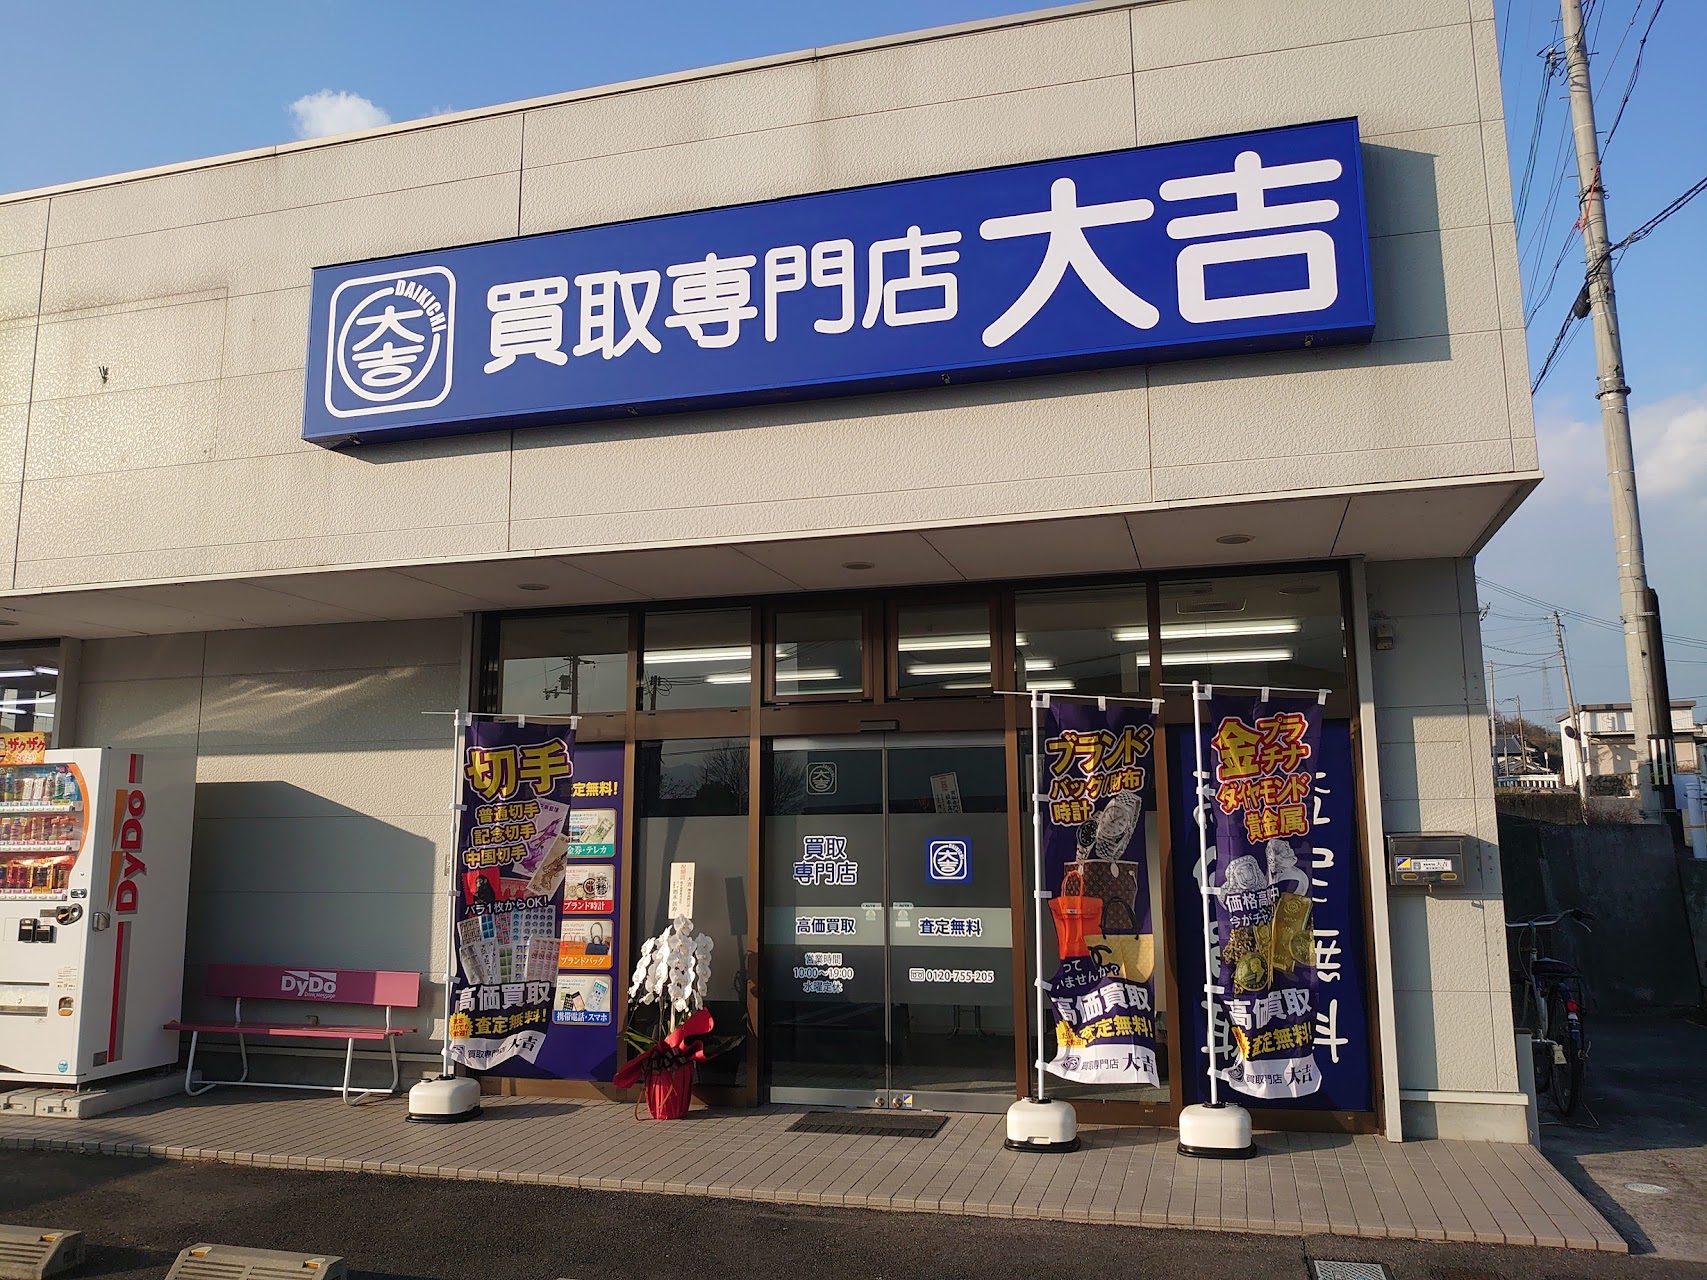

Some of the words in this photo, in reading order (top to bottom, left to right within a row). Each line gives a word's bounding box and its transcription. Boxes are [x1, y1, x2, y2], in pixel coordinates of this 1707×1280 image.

[979, 151, 1342, 348] 大吉
[395, 279, 447, 332] DAIKICHI
[1258, 714, 1305, 745] プラ
[8, 736, 45, 753] ザクザク
[1046, 726, 1152, 777] ブランド
[1213, 719, 1265, 779] 金
[465, 739, 572, 801] 切手
[1260, 744, 1309, 773] チナ
[571, 781, 618, 797] 定無料!
[1218, 774, 1310, 811] ダイヤモンド
[477, 801, 541, 824] 普通切手
[1051, 799, 1093, 824] 時計
[1246, 804, 1307, 841] 貴金属
[472, 823, 537, 845] 記念切手
[464, 845, 527, 866] 中国切手
[804, 836, 847, 860] 買取
[793, 861, 858, 886] 専門店
[464, 896, 549, 916] バラ1枚からOK!
[564, 901, 605, 911] ブランド時計
[1226, 886, 1279, 912] 価格高中
[795, 917, 856, 935] 高価買取
[918, 918, 982, 937] 査定無料
[561, 956, 606, 965] ブランドバッグ
[805, 953, 842, 966] 営業時間
[281, 975, 337, 997] DyDo
[803, 979, 843, 994] 水曜定休
[925, 969, 995, 983] 0120-755-205
[455, 982, 551, 1014] 高価買取
[1051, 982, 1152, 1026] 高価買取
[475, 1008, 547, 1035] 査定無料!
[1080, 1015, 1154, 1042] 査定無料!
[1122, 1052, 1155, 1074] 大吉
[1286, 1064, 1312, 1086] 大吉
